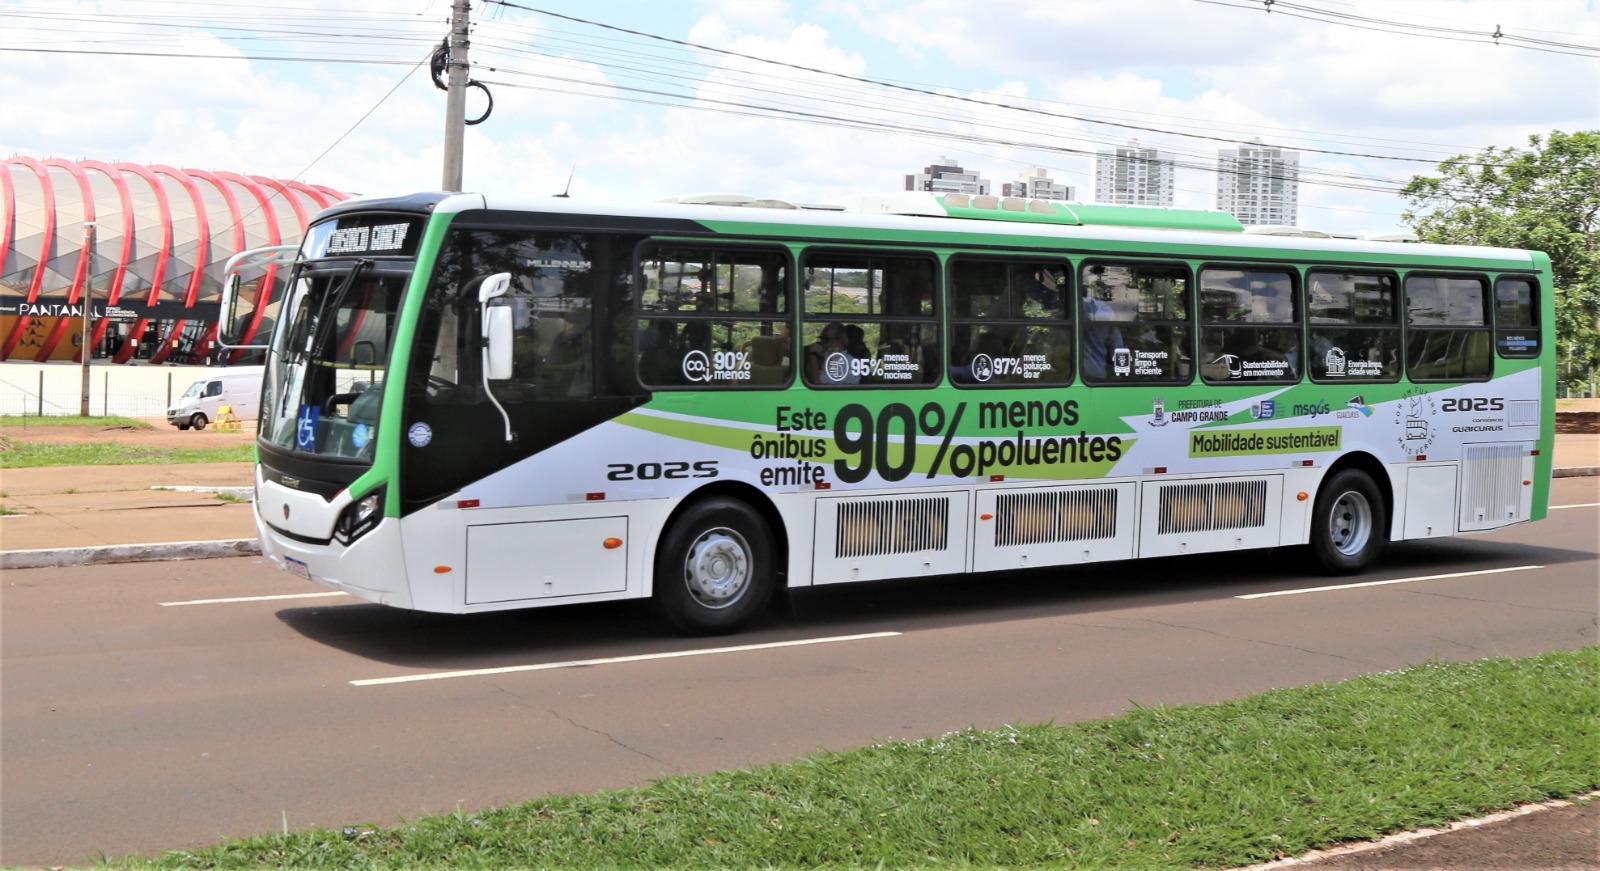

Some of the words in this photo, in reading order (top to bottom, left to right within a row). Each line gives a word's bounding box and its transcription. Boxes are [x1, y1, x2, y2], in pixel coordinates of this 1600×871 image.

[527, 260, 591, 268] MILLENNIUM
[884, 354, 909, 362] menos
[1023, 354, 1046, 362] menos
[1134, 350, 1168, 360] Transporte
[713, 351, 751, 370] 90%
[1134, 358, 1152, 368] limpo
[1242, 360, 1289, 369] Sustentabilidade
[1348, 360, 1367, 369] Energia
[851, 358, 884, 376] 95%
[884, 361, 919, 371] emissões
[993, 357, 1023, 375] 97%
[1023, 361, 1051, 371] poluição
[1134, 366, 1163, 375] eficiente
[714, 370, 751, 380] menos
[884, 370, 912, 379] nocivas
[1023, 371, 1033, 379] do
[1032, 371, 1041, 379] ar
[1252, 368, 1284, 377] movimento
[1347, 367, 1366, 376] cidade
[1366, 367, 1381, 376] verde
[1178, 400, 1212, 409] PREFEITURA
[1214, 399, 1222, 408] DE
[1441, 397, 1505, 412] 2025
[776, 406, 827, 431] Este
[979, 400, 1079, 429] menos
[1171, 412, 1198, 423] CAMPO
[1199, 411, 1229, 422] GRANDE
[750, 433, 826, 459] ônibus
[833, 401, 976, 484] 90%
[1192, 433, 1264, 453] Mobilidade
[1267, 429, 1340, 450] sustentável
[978, 431, 1121, 476] poluentes
[607, 460, 719, 482] 2025
[760, 459, 825, 487] emite
